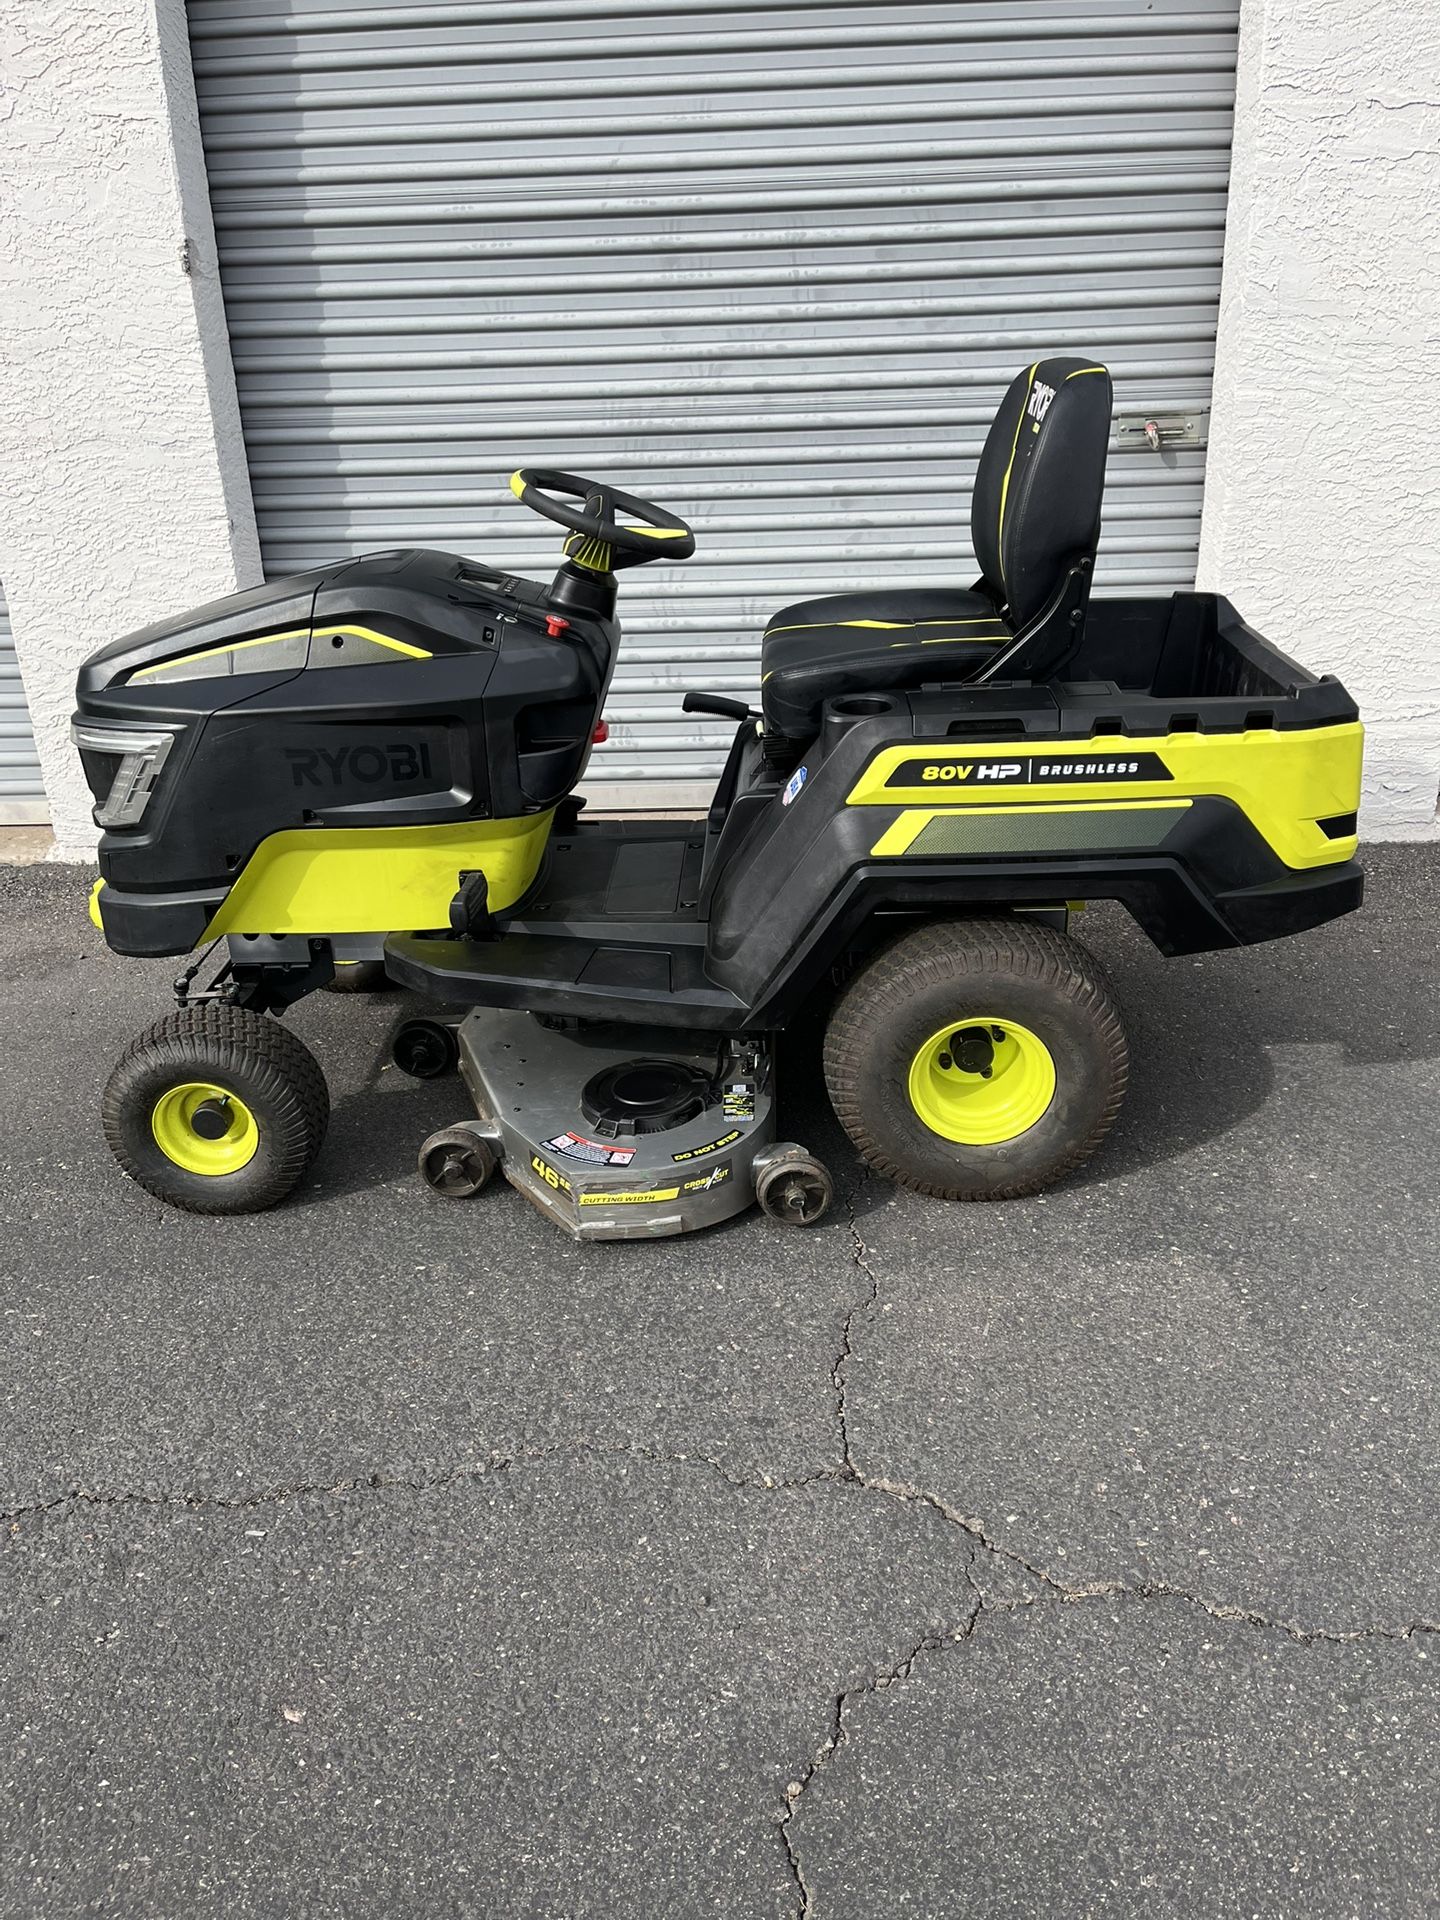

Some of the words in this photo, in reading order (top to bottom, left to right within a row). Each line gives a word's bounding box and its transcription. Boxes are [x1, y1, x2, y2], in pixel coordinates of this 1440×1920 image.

[285, 742, 433, 787] RYOBI
[921, 765, 974, 781] 80V
[976, 764, 1022, 780] HP
[1039, 762, 1139, 777] BRUSHLESS
[674, 1152, 693, 1161] DO
[693, 1143, 716, 1156] NOT
[716, 1130, 740, 1147] STEP
[714, 1168, 729, 1180] CUT
[583, 1196, 624, 1204] CUTTING
[625, 1195, 656, 1203] WIDTH
